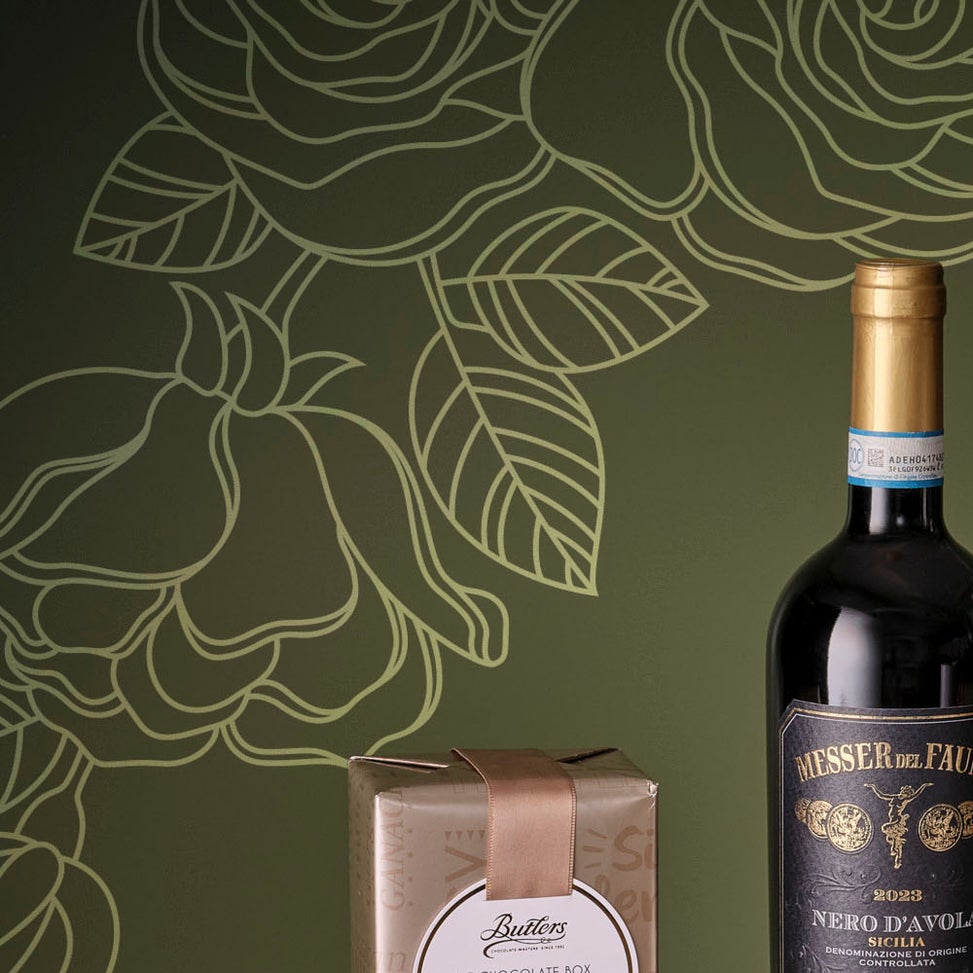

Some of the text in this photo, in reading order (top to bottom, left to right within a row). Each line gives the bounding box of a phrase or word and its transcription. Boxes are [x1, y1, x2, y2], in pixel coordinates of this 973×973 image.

[796, 741, 893, 782] MESSER
[896, 753, 923, 769] DEL
[873, 889, 923, 901] 2023
[811, 909, 878, 932] NERO
[480, 913, 567, 944] Butlers
[868, 936, 926, 948] SICILIA
[825, 946, 911, 958] DENOMINAZIONE
[928, 946, 968, 956] ORIGINE
[859, 958, 936, 967] CONTROLLATA
